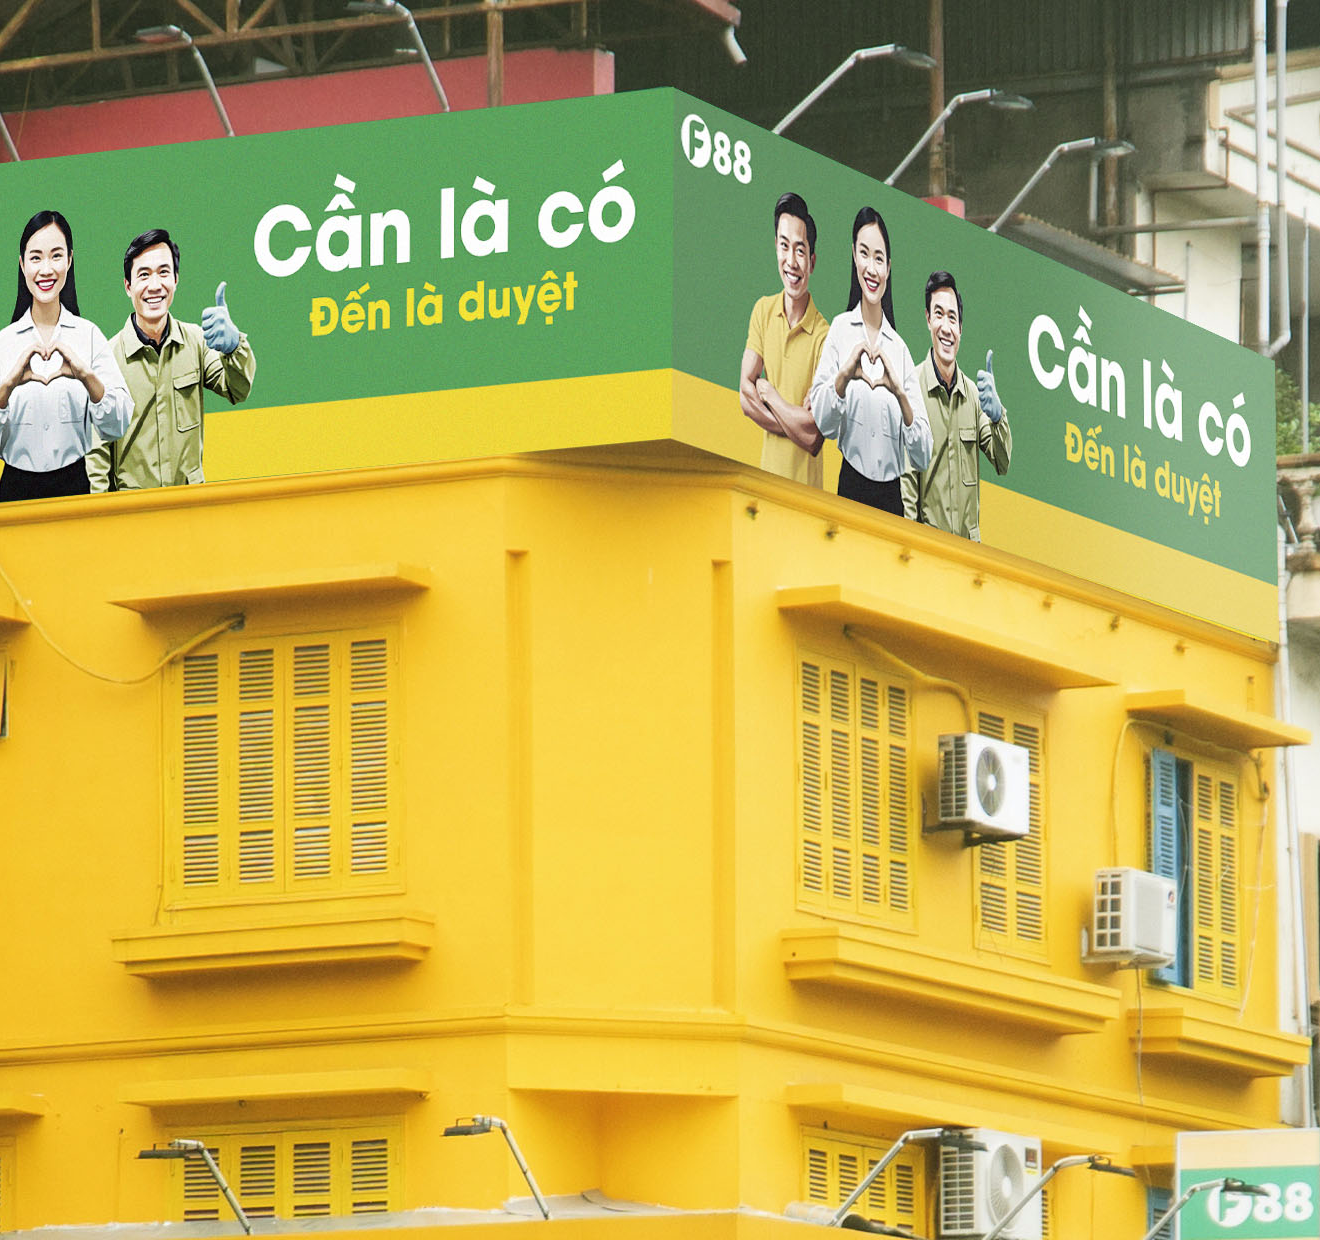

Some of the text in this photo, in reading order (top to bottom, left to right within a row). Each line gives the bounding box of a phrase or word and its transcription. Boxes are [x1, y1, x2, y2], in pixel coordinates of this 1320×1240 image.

[681, 114, 752, 184] F88
[254, 159, 636, 276] Cần là có
[309, 271, 578, 336] Đến là duyệt
[1028, 305, 1251, 467] Cần là có
[1065, 422, 1221, 524] Đến là duyệt
[1207, 1178, 1314, 1228] F88
